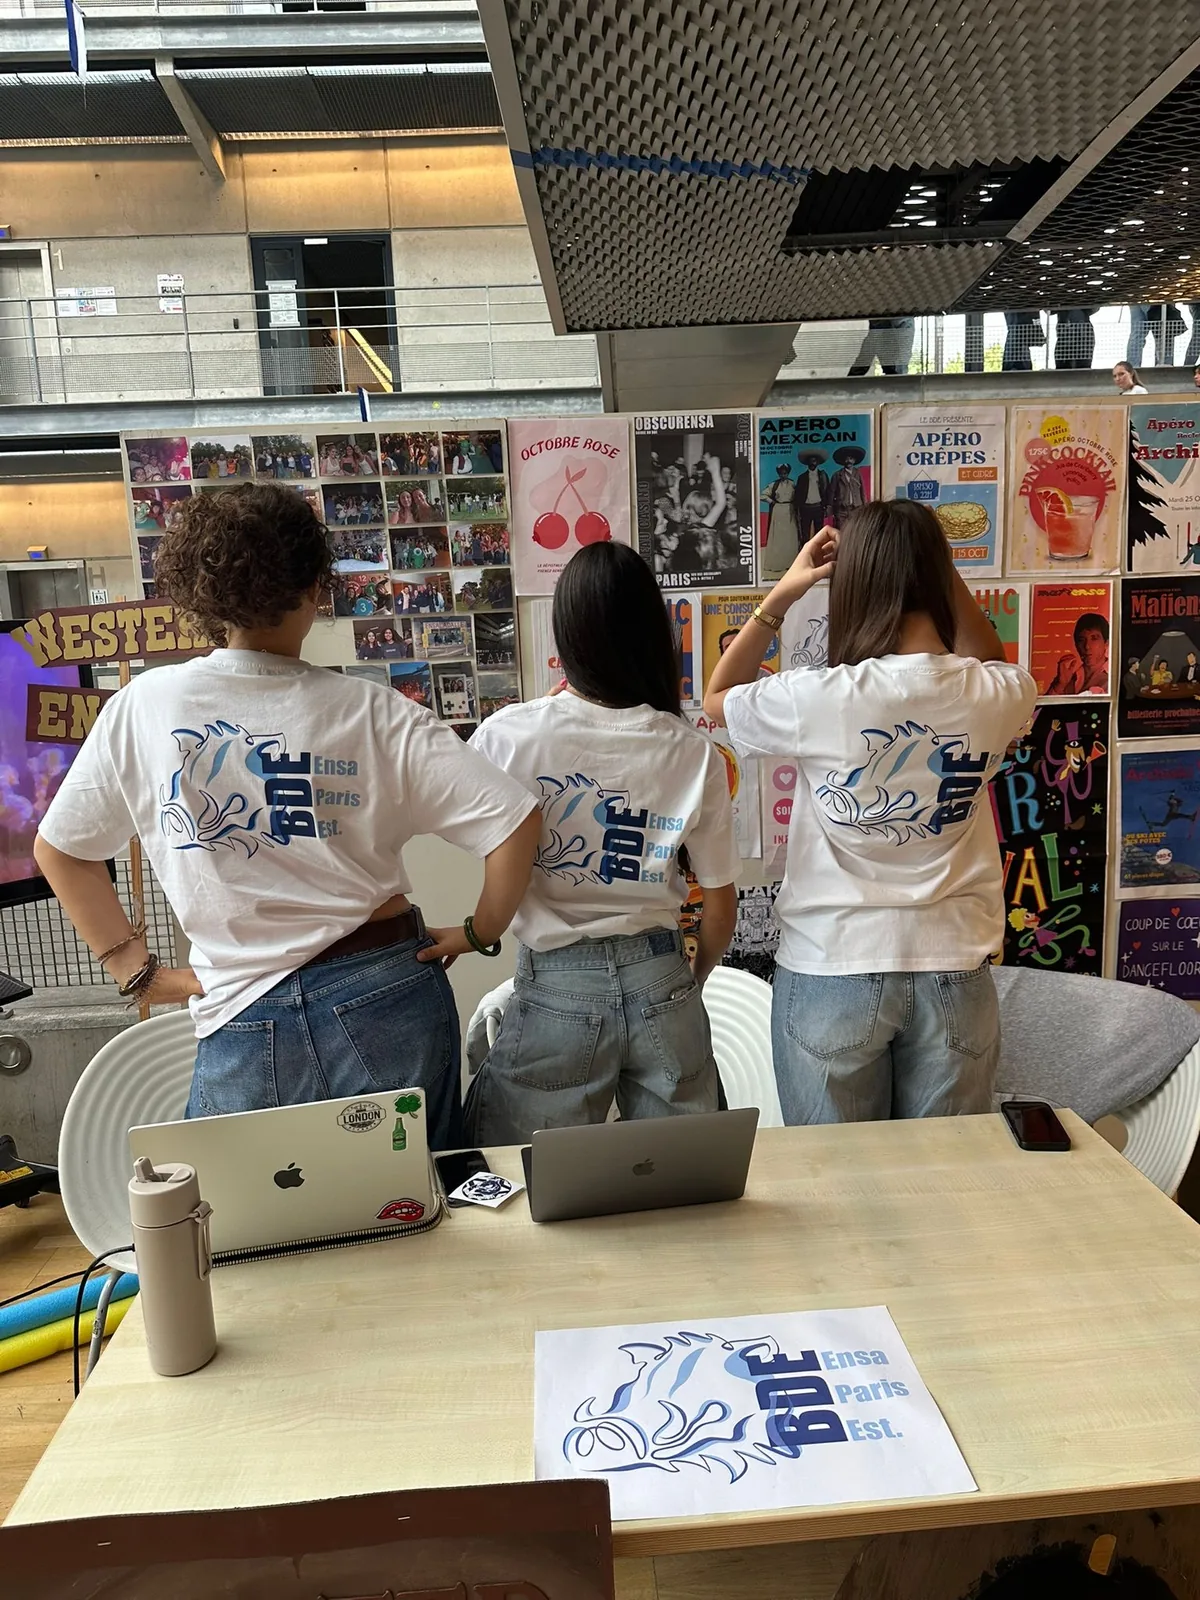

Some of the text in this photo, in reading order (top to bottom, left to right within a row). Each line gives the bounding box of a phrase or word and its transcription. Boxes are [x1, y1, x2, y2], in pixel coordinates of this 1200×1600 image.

[635, 415, 715, 431] OBSCURENSA
[943, 416, 974, 424] PRÉSENTE
[1147, 417, 1196, 433] Apéro
[760, 432, 857, 446] MEXICAIN
[912, 428, 982, 447] APÉRO
[1077, 437, 1104, 453] OCTOBRE
[521, 436, 621, 461] OCTOBRE ROSE
[906, 447, 986, 466] CRÊPES
[1136, 442, 1200, 460] Archi
[973, 470, 994, 478] CIDRE
[1019, 446, 1117, 496] PINK COCKTAIL
[739, 526, 752, 566] 20/05
[957, 548, 987, 558] 15 OCT
[655, 572, 691, 586] PARIS
[360, 603, 367, 613] 3
[704, 604, 721, 615] UNE
[724, 603, 752, 614] CONSO
[1131, 593, 1200, 618] Mafien
[10, 605, 218, 668] WESTER
[314, 755, 358, 776] Ensa
[260, 752, 317, 838] BDE
[315, 788, 361, 807] Paris
[928, 751, 990, 826] BDE
[318, 819, 343, 839] Est.
[649, 813, 684, 831] Ensa
[600, 805, 649, 882] BDE
[645, 842, 678, 859] Pari
[640, 869, 668, 883] Est.
[1125, 916, 1200, 931] COUP DE CŒ
[1151, 941, 1184, 952] SUR LE
[1122, 961, 1200, 979] DANCEFLOOR
[343, 1110, 381, 1125] LONDON
[821, 1349, 890, 1371] Ensa
[746, 1349, 849, 1448] BDE
[834, 1378, 910, 1404] Paris
[846, 1418, 904, 1442] Est.
